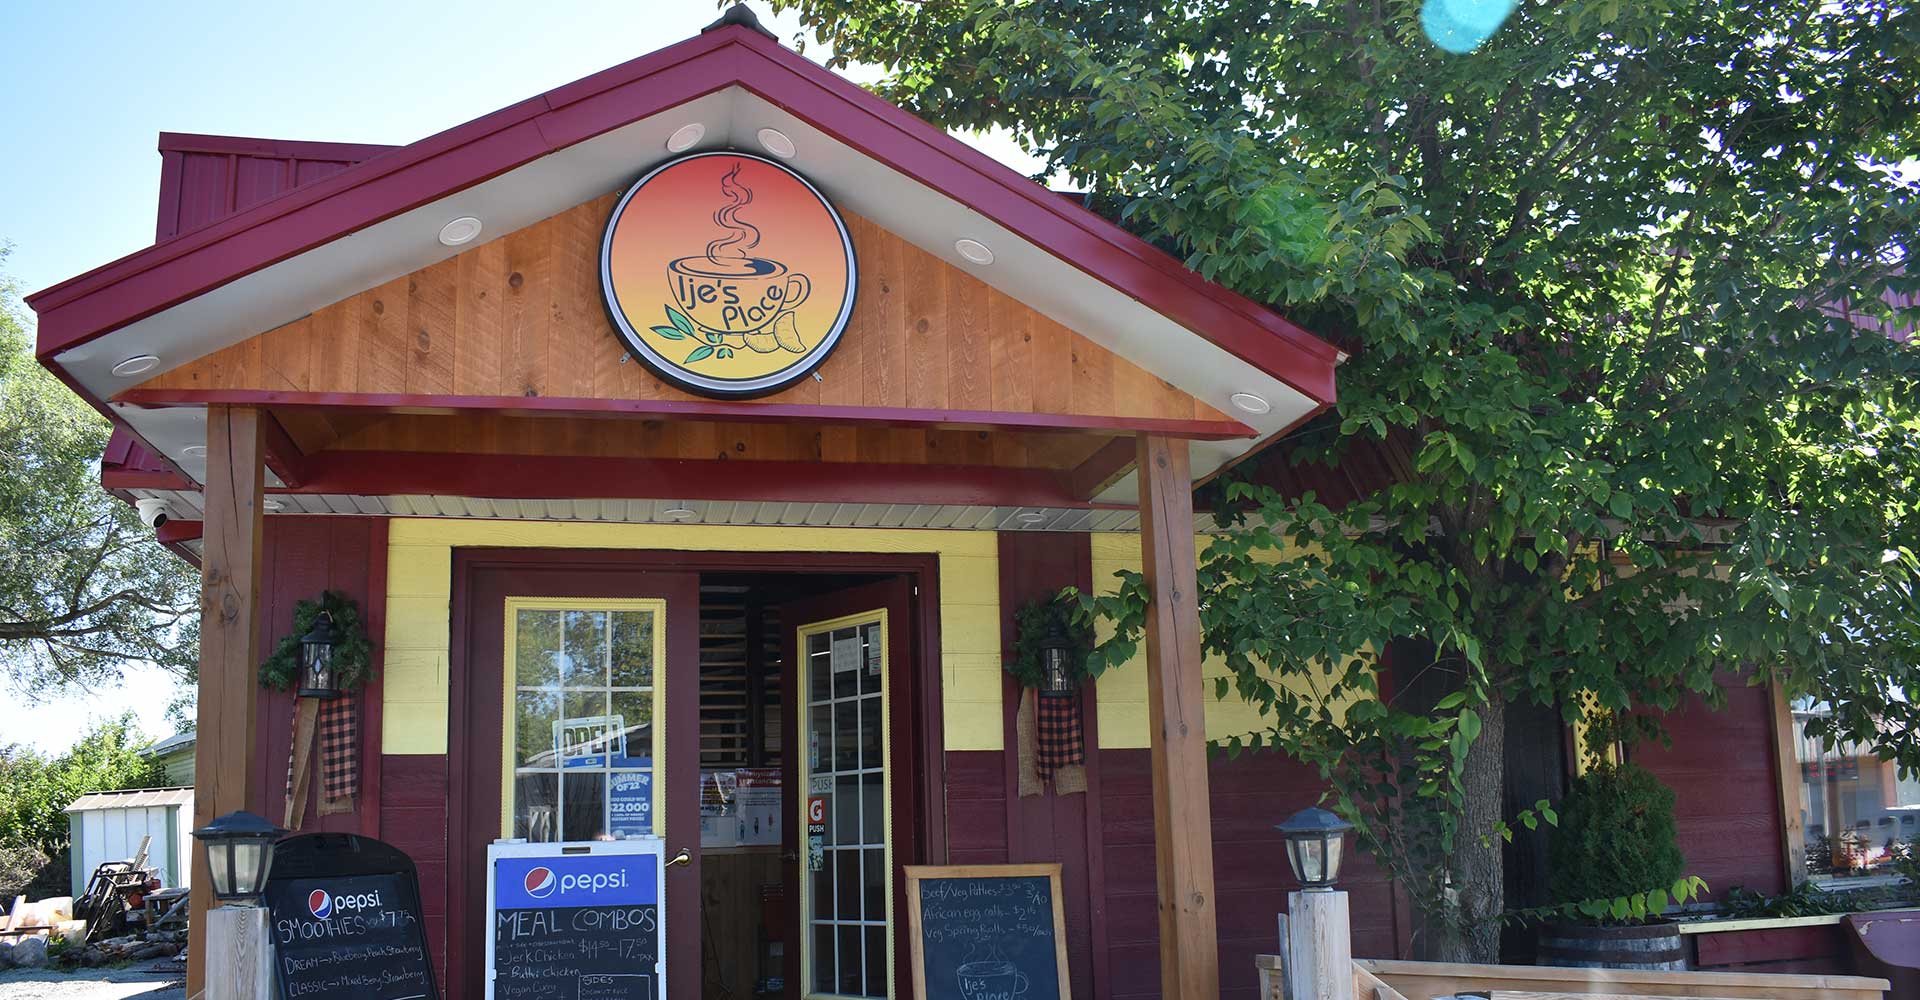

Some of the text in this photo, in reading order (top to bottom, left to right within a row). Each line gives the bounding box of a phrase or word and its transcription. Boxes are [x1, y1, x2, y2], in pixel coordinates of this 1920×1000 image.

[678, 275, 740, 311] Ije's
[721, 284, 784, 330] Place
[616, 783, 629, 792] OF
[809, 799, 823, 822] G
[808, 824, 825, 833] PUSH
[560, 868, 627, 895] pepsi
[334, 889, 382, 914] pepsi
[923, 905, 962, 921] African
[277, 915, 367, 944] SMOOTHIES
[497, 908, 656, 941] MEAL COMBOS
[925, 928, 944, 944] Veg
[944, 925, 979, 941] Spring
[285, 957, 319, 975] DREAM
[503, 948, 575, 966] Jerk Chicken
[289, 979, 328, 997] CLASSIC
[503, 984, 532, 997] Vegan
